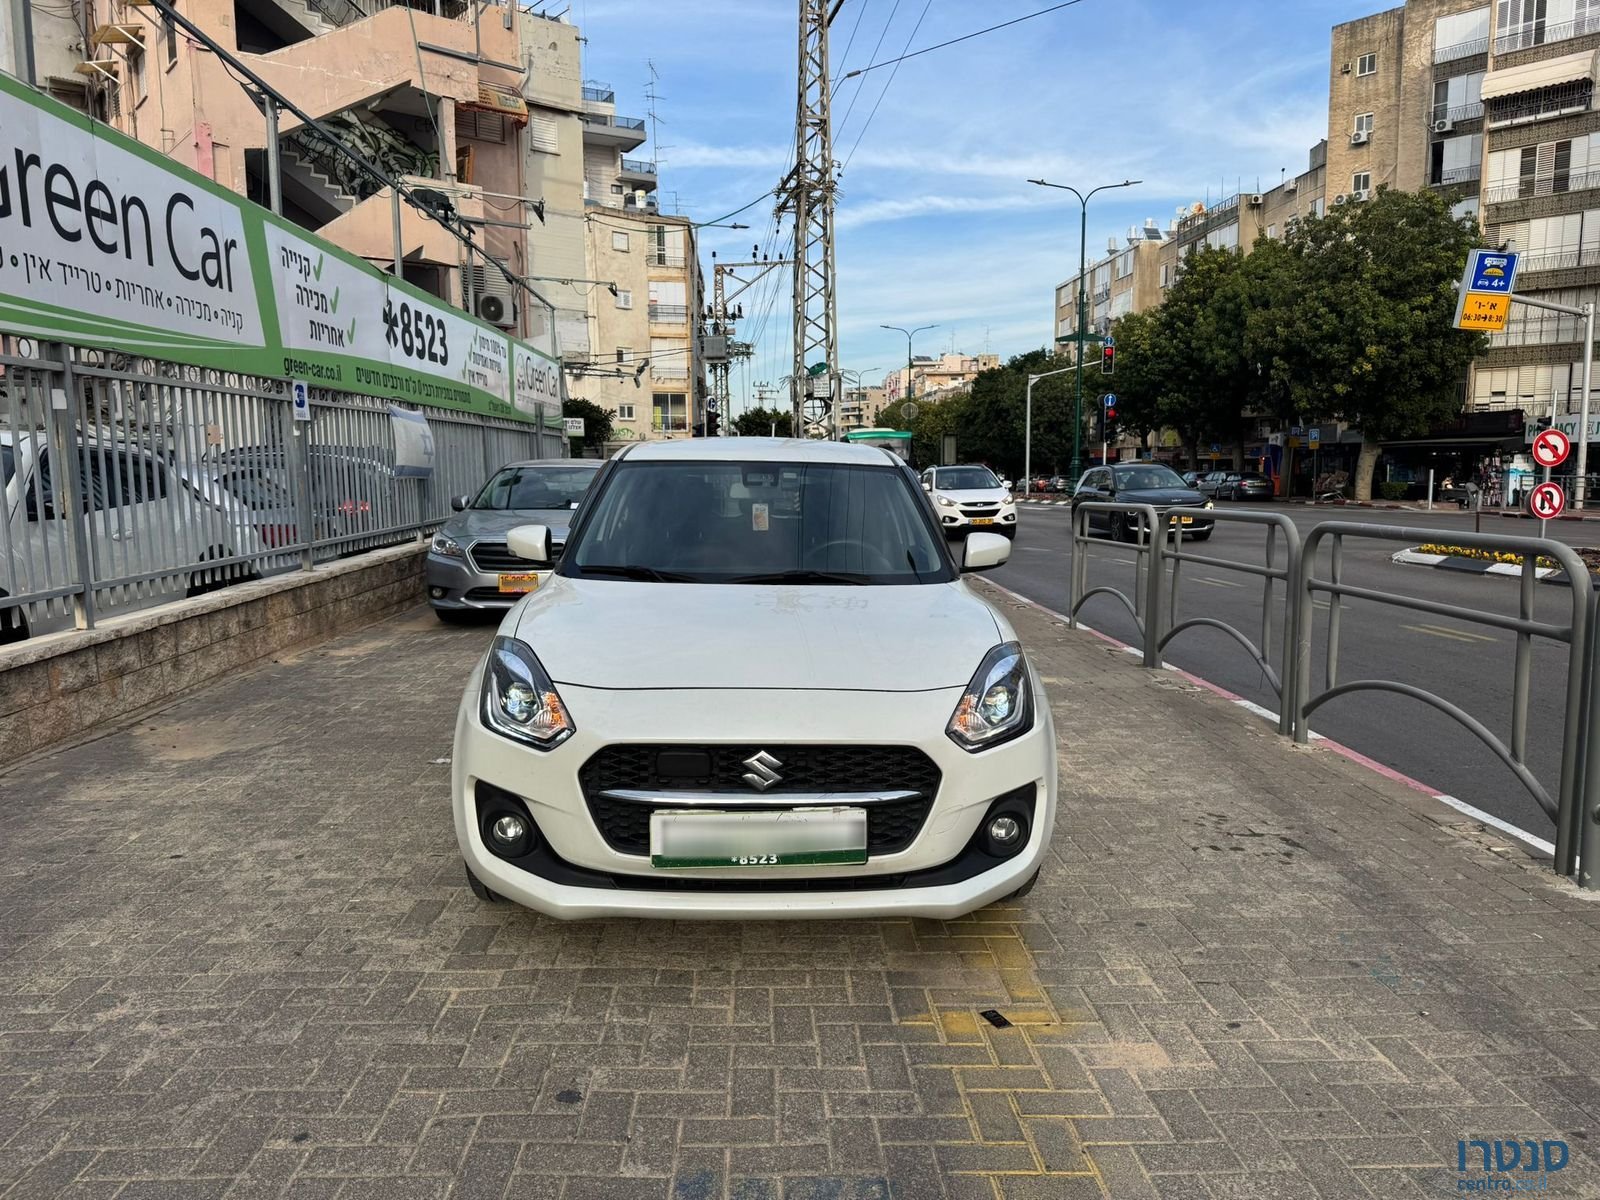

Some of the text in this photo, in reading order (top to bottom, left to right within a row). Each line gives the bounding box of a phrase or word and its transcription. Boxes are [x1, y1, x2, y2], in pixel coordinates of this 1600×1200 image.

[166, 192, 238, 293] Car
[23, 252, 53, 284] אין
[57, 261, 101, 294] טרייד
[281, 246, 310, 283] קנייה
[115, 278, 164, 310] אחריות
[175, 294, 213, 322] מכירה
[296, 283, 328, 314] מכירה
[221, 308, 244, 335] קניה
[309, 319, 345, 348] אחריות
[283, 357, 342, 382] green-car.co.il
[355, 366, 382, 387] חדשים
[526, 355, 548, 396] Green
